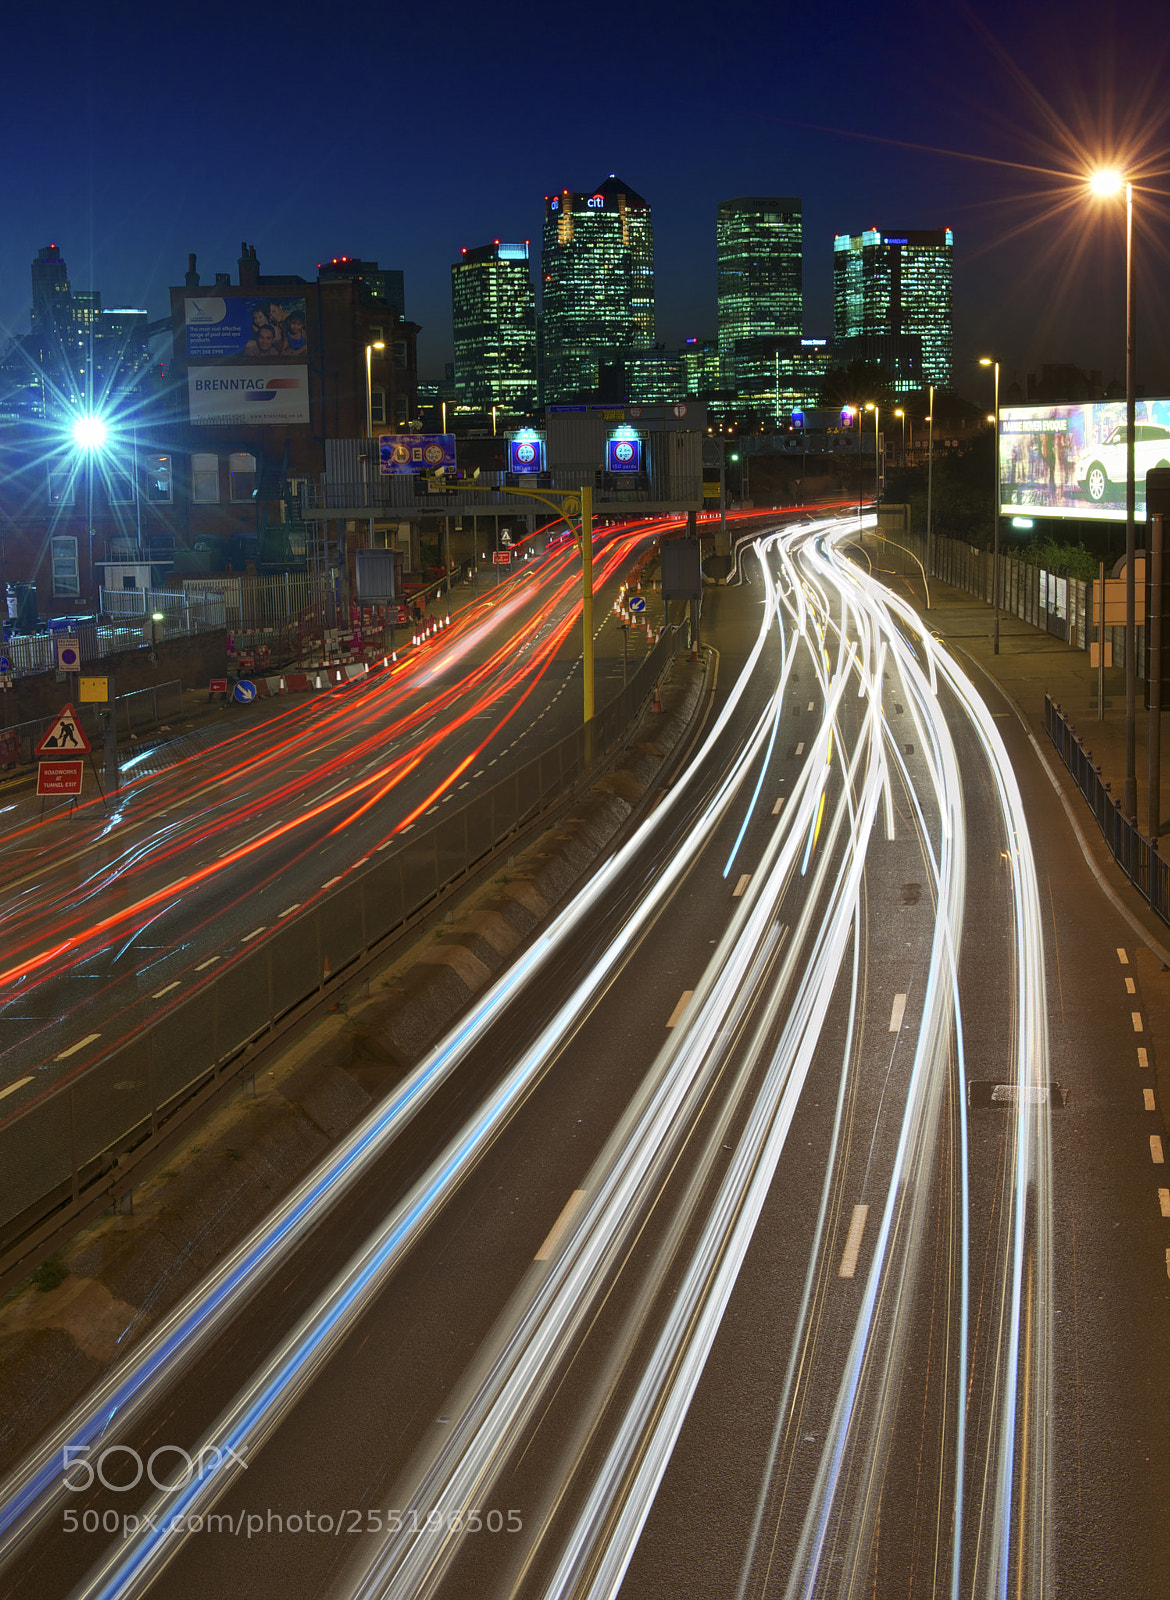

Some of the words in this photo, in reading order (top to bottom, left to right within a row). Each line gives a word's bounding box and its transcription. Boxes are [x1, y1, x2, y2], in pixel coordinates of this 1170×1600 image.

[587, 197, 604, 208] citi
[195, 378, 264, 391] BRENNTAG
[1002, 421, 1023, 432] RANGE
[1023, 420, 1042, 432] ROVER
[1042, 419, 1068, 432] EVOQUE
[413, 449, 421, 459] E
[43, 768, 78, 776] ROADWORKS
